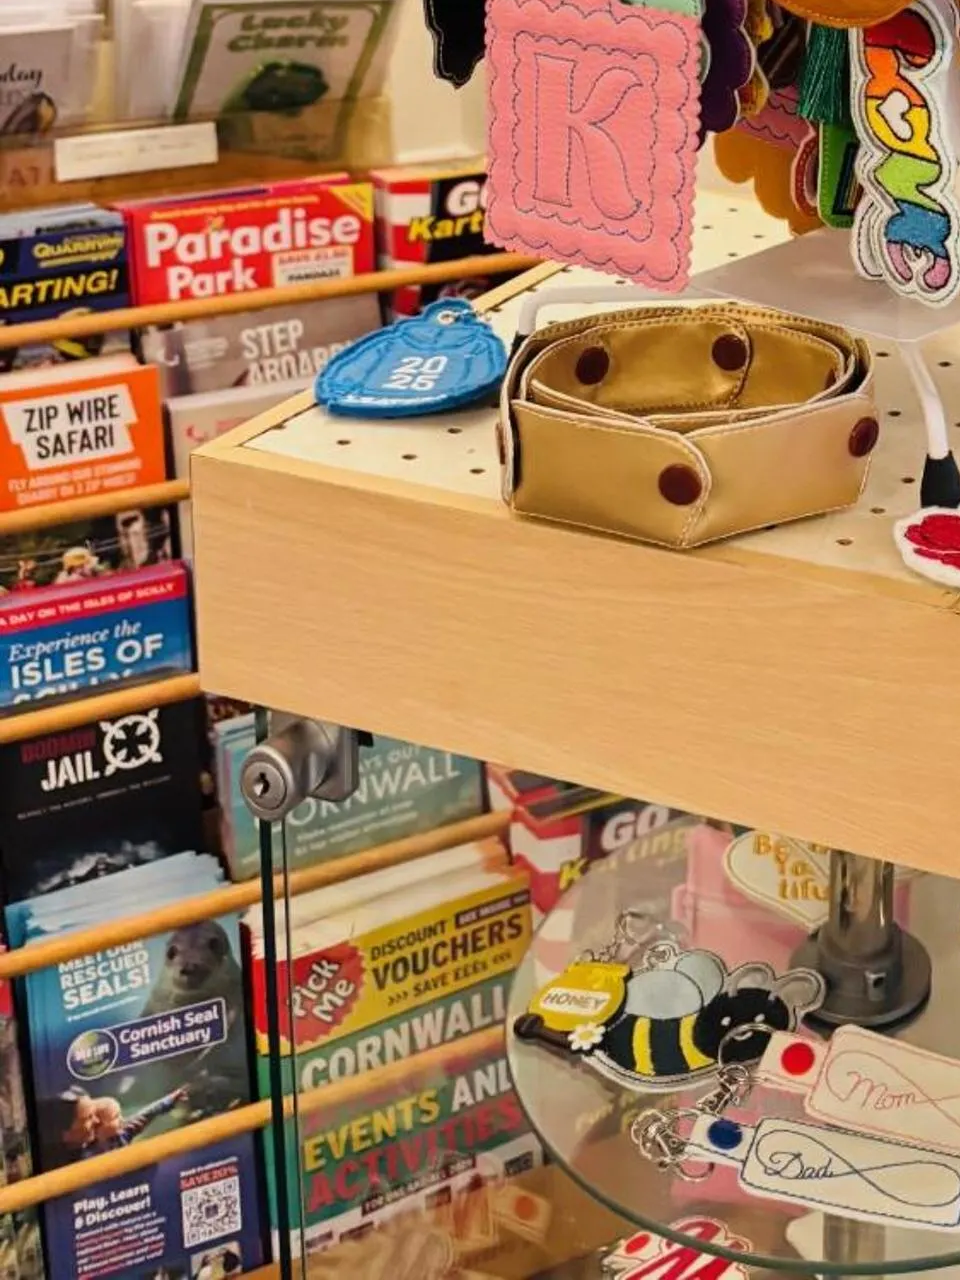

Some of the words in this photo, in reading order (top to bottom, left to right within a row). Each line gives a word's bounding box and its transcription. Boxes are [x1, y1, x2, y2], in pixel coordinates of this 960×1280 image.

[533, 53, 644, 221] K
[144, 207, 361, 268] Paradise
[166, 258, 258, 301] Park
[241, 318, 304, 360] STEP
[382, 375, 437, 392] 25
[399, 355, 449, 375] 20
[23, 405, 59, 433] ZIP
[66, 393, 121, 426] WIRE
[36, 423, 115, 460] SAFARI
[9, 610, 36, 626] DAY
[37, 606, 57, 619] ON
[59, 601, 82, 615] THE
[84, 594, 116, 610] ISLES
[117, 590, 134, 602] OF
[136, 582, 175, 599] SCILLY
[8, 628, 110, 663] Experience
[113, 619, 142, 639] the
[11, 646, 106, 690] ISLES
[116, 633, 164, 664] OF
[40, 750, 101, 792] JAIL
[370, 918, 450, 963] DISCOUNT
[371, 911, 524, 993] VOUCHERS
[60, 949, 149, 991] RESCUED
[63, 963, 151, 1010] SEALS!
[290, 958, 341, 1018] Pick
[411, 974, 451, 998] SAVE
[312, 977, 356, 1023] Me
[543, 991, 609, 1011] HONEY
[119, 1015, 182, 1044] Cornish
[184, 1005, 220, 1028] Seal
[129, 1027, 212, 1060] Sanctuary
[300, 985, 506, 1091] CORNWALL
[302, 1087, 440, 1173] EVENTS
[306, 1091, 522, 1214] ACTIVITIES
[767, 1151, 835, 1180] Dad
[85, 1195, 151, 1228] Discover!
[110, 1182, 150, 1204] Learn
